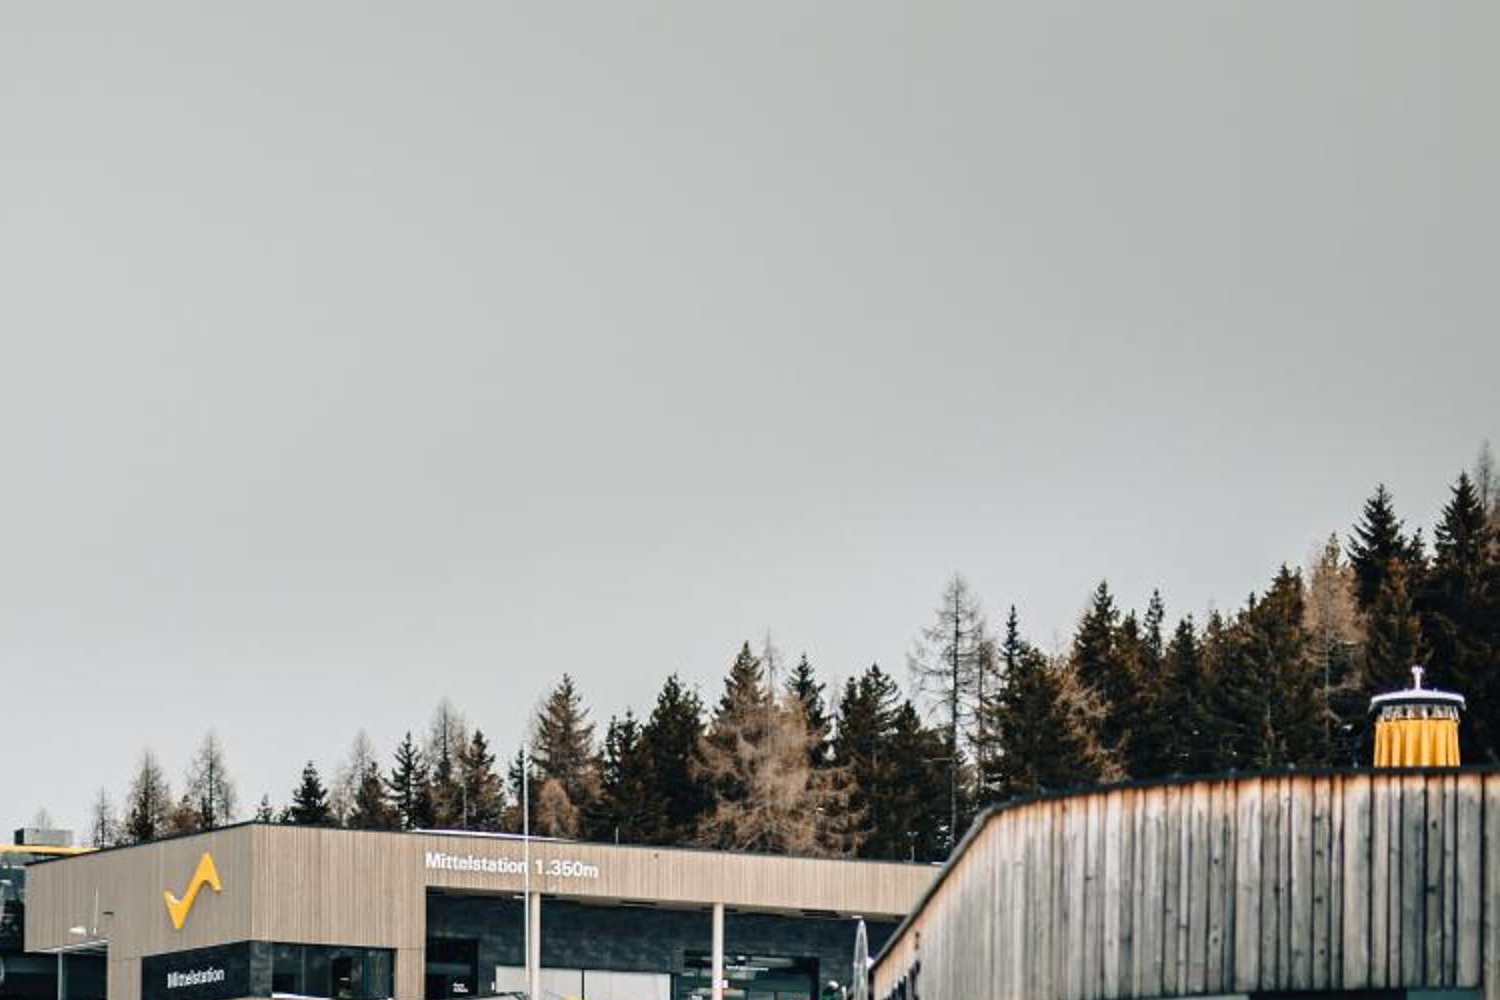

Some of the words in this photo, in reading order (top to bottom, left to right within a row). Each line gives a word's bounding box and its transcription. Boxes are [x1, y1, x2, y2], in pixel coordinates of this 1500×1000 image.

[425, 852, 528, 873] Mittelstation
[535, 858, 598, 879] 1.350m
[167, 967, 225, 989] Mittelstation
